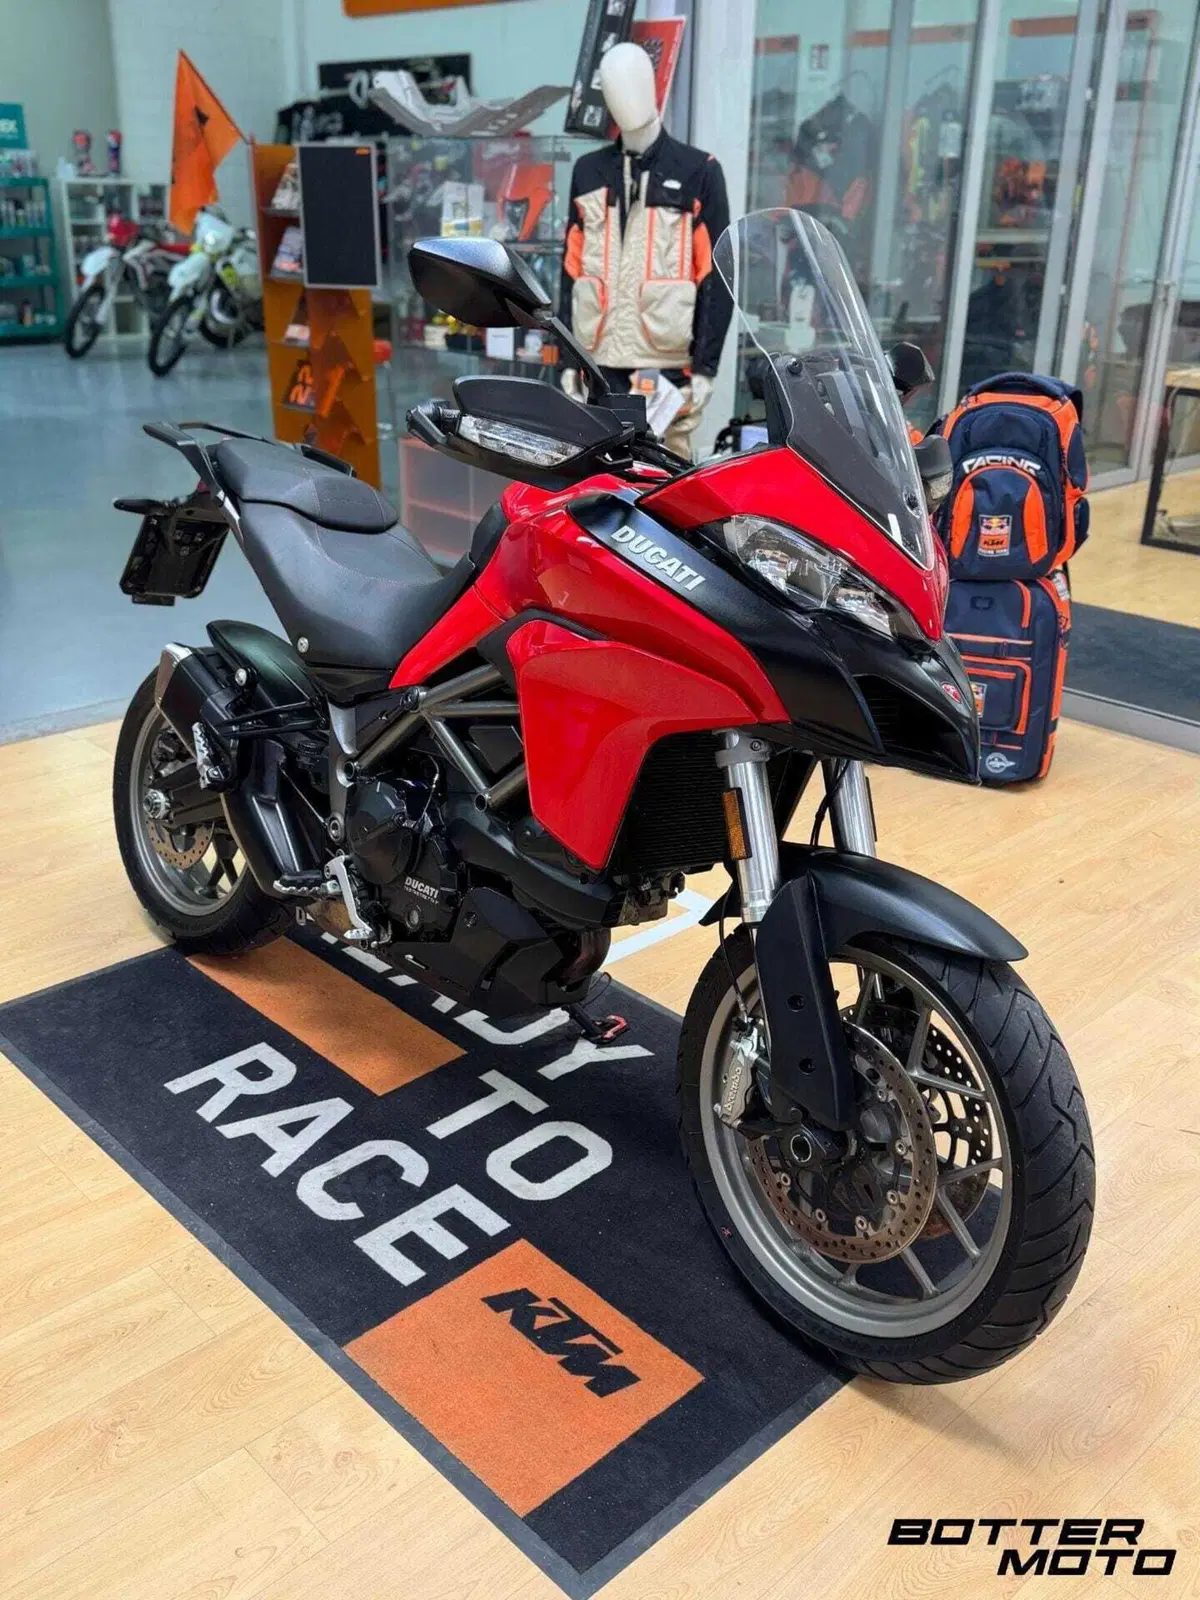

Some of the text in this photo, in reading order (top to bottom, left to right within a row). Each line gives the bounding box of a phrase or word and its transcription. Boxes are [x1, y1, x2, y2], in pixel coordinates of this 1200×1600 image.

[962, 455, 1041, 476] RACING
[611, 525, 706, 591] DUCATI
[405, 876, 439, 898] DUCATI
[724, 1066, 741, 1112] brembo
[164, 1042, 511, 1287] RACE
[425, 1069, 613, 1201] TO
[480, 1287, 641, 1398] KTM
